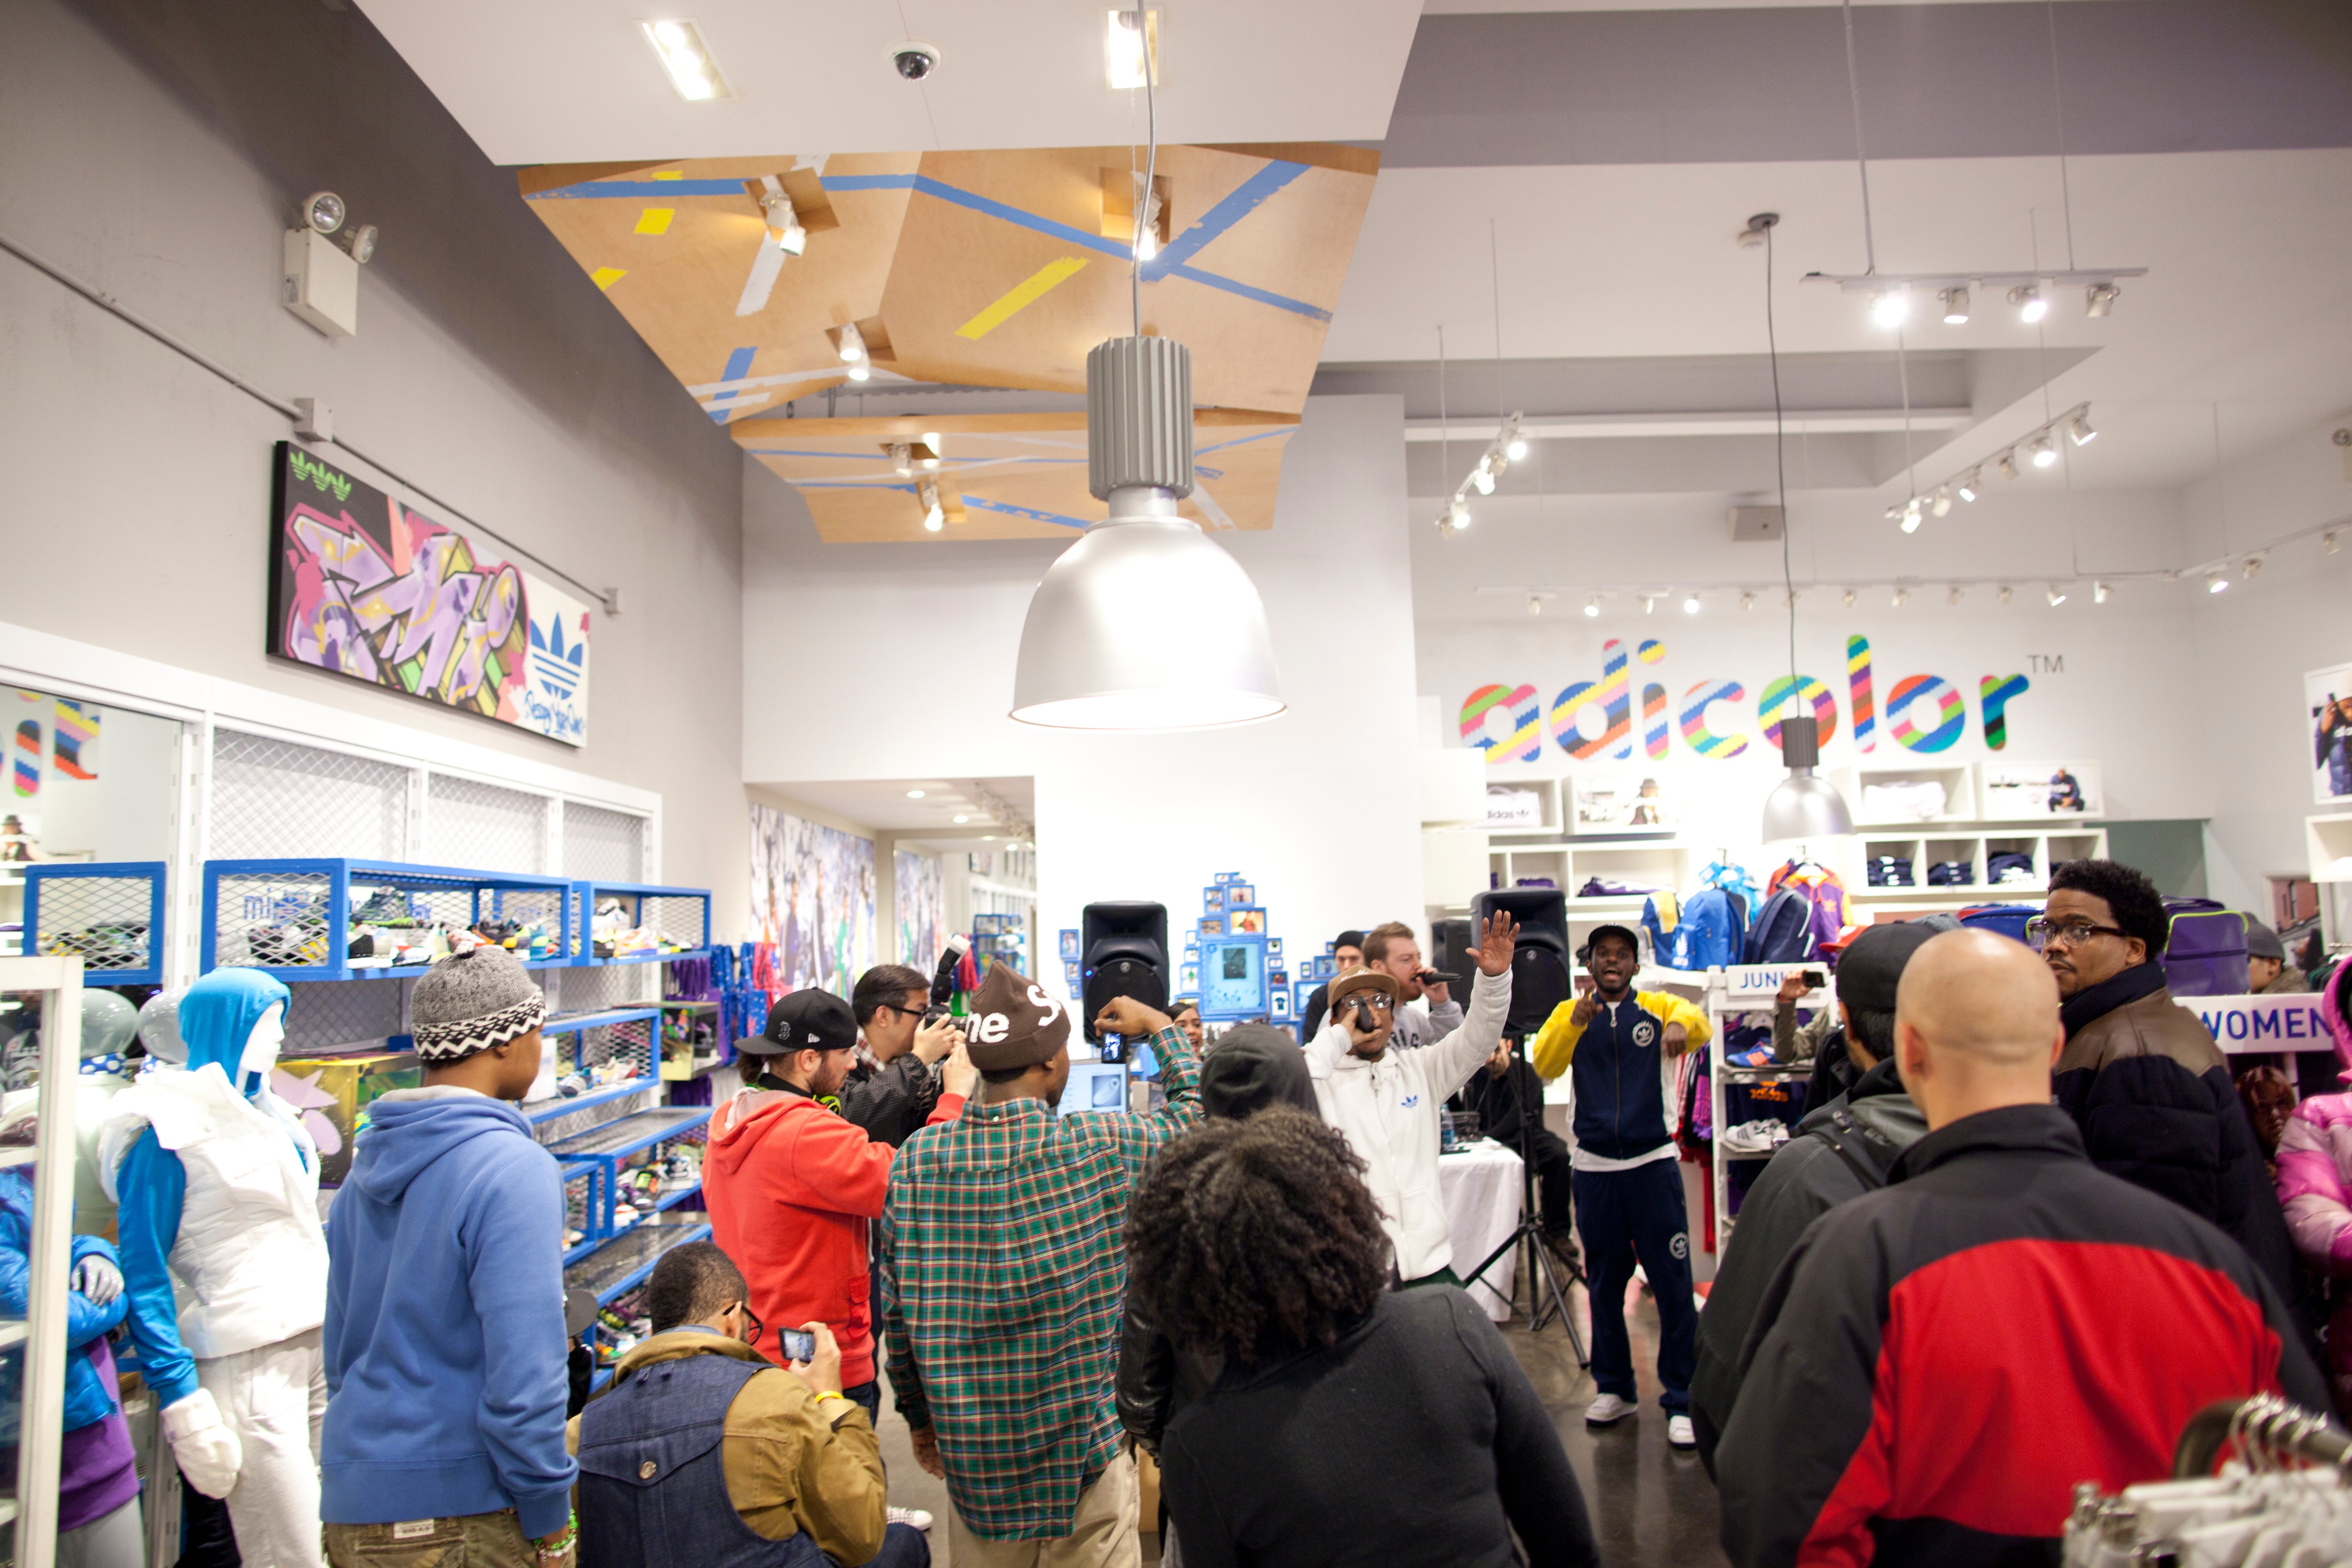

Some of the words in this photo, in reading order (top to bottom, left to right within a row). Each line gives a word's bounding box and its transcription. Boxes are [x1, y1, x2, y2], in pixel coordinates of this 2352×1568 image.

[1460, 634, 2030, 765] adicolor
[2027, 654, 2063, 673] TM
[1740, 971, 1784, 988] JUNI
[2201, 1007, 2334, 1042] WOMEN
